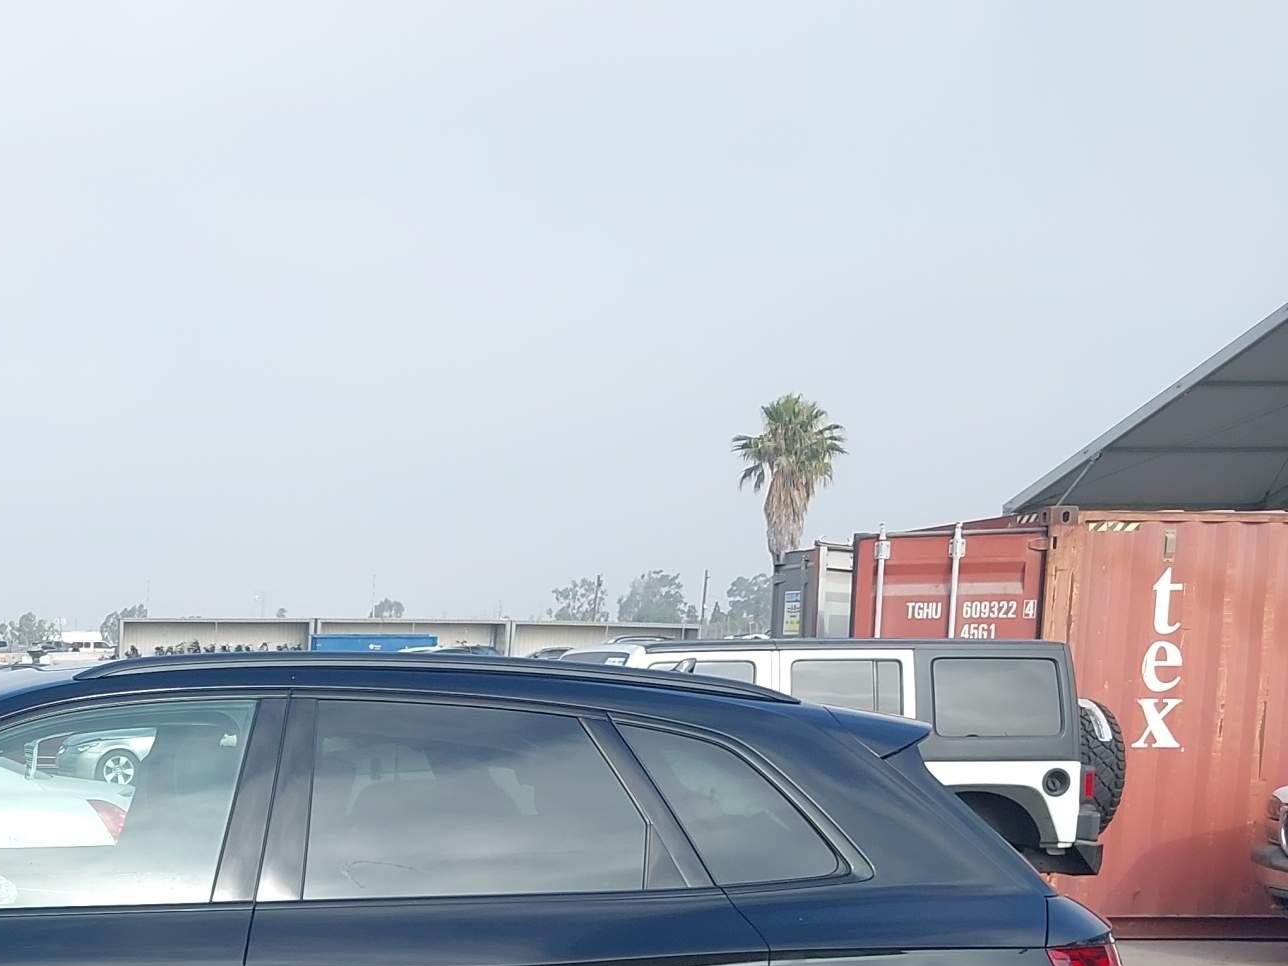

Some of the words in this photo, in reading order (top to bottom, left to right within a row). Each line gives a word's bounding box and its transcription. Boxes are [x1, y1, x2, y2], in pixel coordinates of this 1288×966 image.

[906, 602, 942, 619] TGHU
[962, 601, 1017, 618] 609322
[1025, 602, 1034, 618] 4
[960, 623, 996, 639] 45G1
